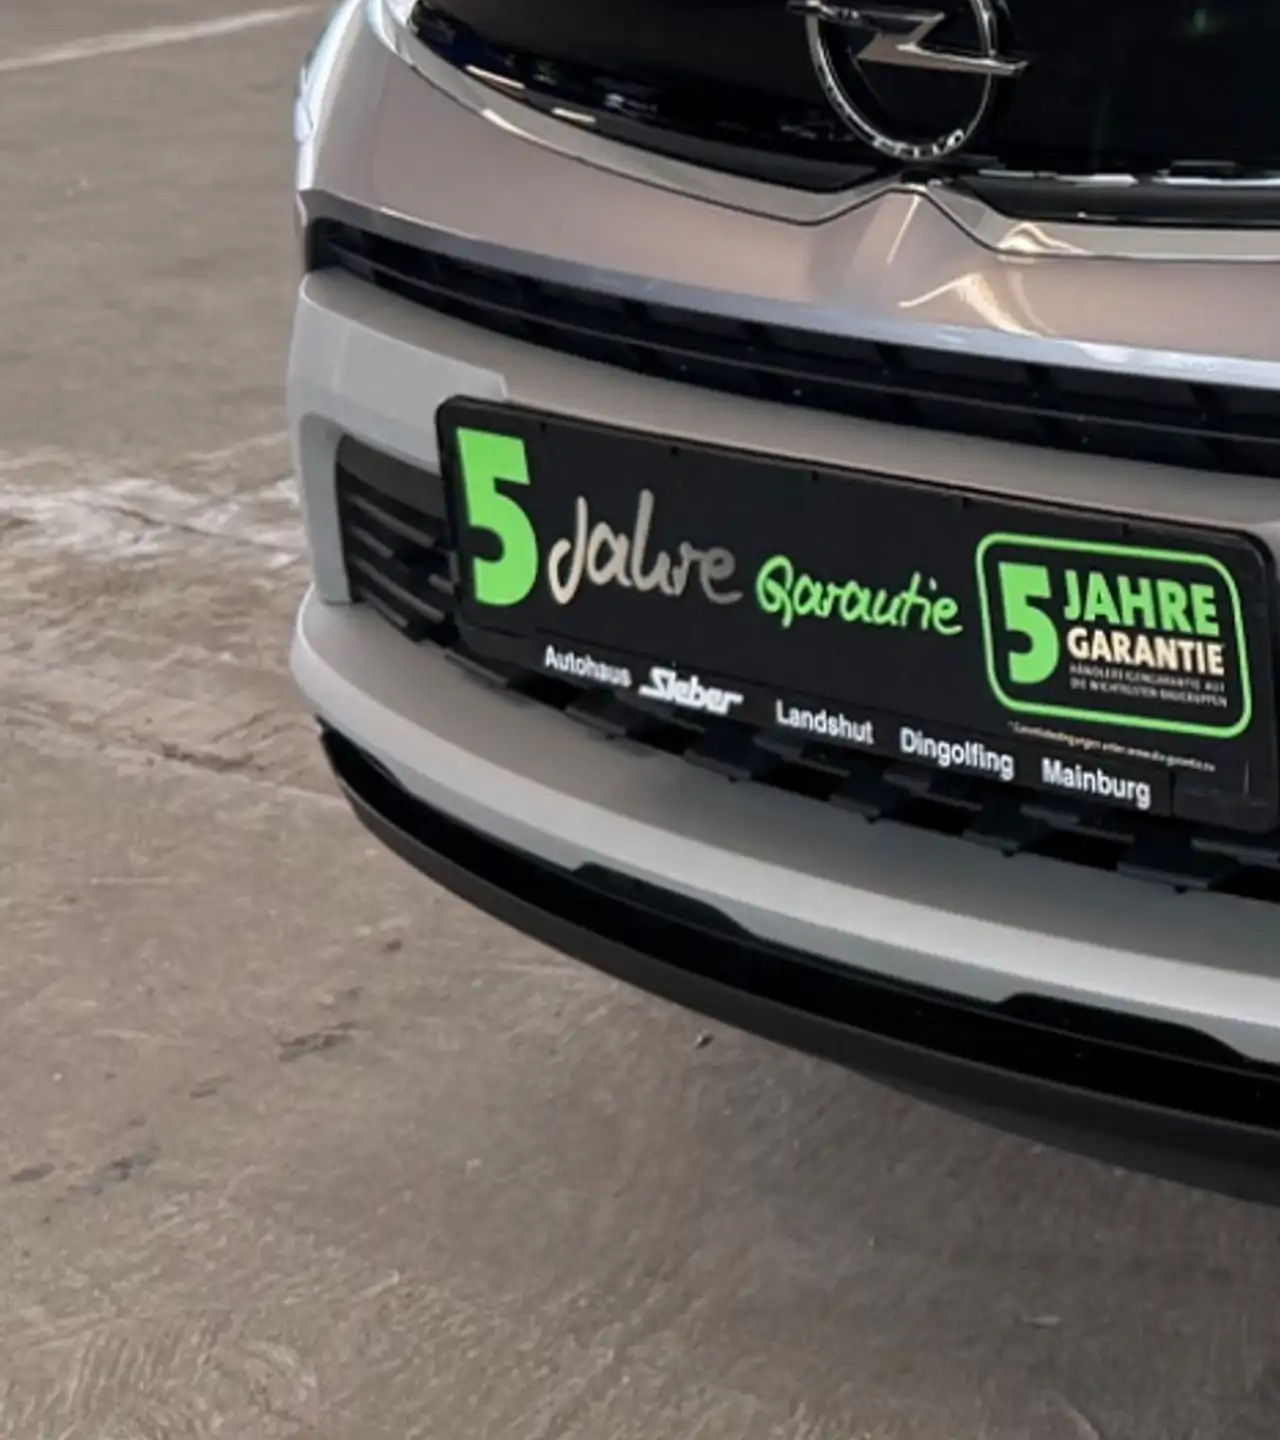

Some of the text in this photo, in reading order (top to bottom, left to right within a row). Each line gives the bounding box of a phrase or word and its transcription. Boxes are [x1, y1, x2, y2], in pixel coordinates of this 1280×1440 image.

[456, 426, 964, 636] 5 Jahre Garantie
[997, 560, 1220, 685] 5 JAHRE
[1066, 625, 1227, 677] GARANTIE
[545, 644, 632, 688] Autohaus
[637, 664, 745, 716] Sieber
[775, 698, 875, 746] Landshut
[899, 726, 1015, 782] Dingolfing
[1040, 757, 1152, 810] Mainburg
